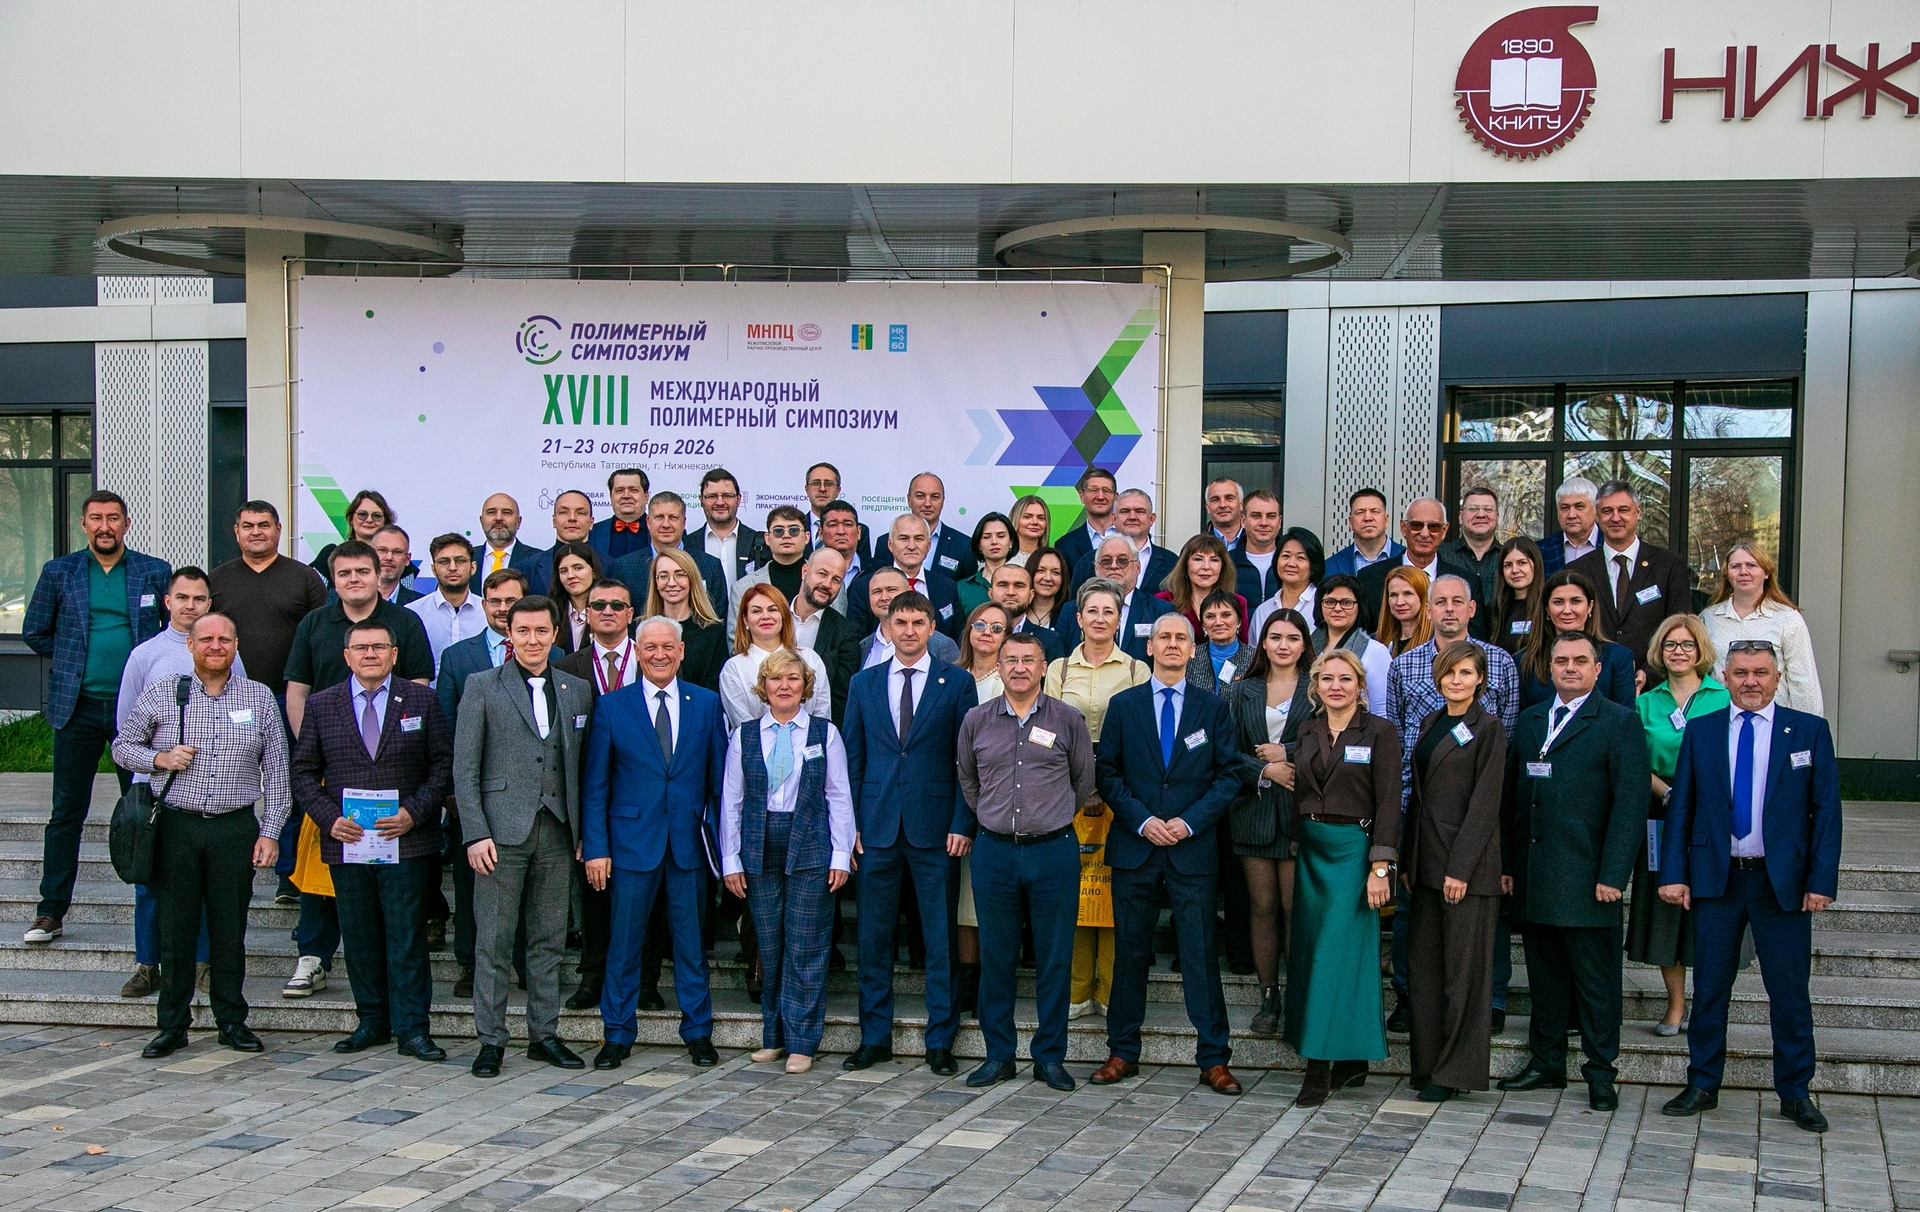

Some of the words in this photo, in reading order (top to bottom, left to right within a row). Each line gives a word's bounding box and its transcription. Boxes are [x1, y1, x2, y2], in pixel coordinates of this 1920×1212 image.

[1500, 38, 1554, 54] 1890
[1488, 115, 1562, 131] КНИТУ
[570, 320, 708, 341] ПОЛИМЕРНЫЙ
[747, 323, 794, 342] МНПЦ
[570, 343, 691, 362] СИМПОЗИУМ
[541, 374, 629, 426] XVIII
[650, 378, 820, 405] МЕЖДУНАРОДНЫЙ
[650, 404, 777, 428] ПОЛИМЕРНЫЙ
[785, 408, 898, 430] СИМПОЗИУМ
[600, 438, 669, 459] октября
[673, 439, 715, 455] 2026
[541, 459, 597, 471] Республика
[600, 460, 650, 471] Татарстан,
[653, 462, 660, 470] г.
[584, 491, 605, 499] ОВАЯ
[755, 494, 809, 502] ЭКОНОМИЧЕСК
[861, 495, 906, 503] ПОСЕЩЕНИЕ
